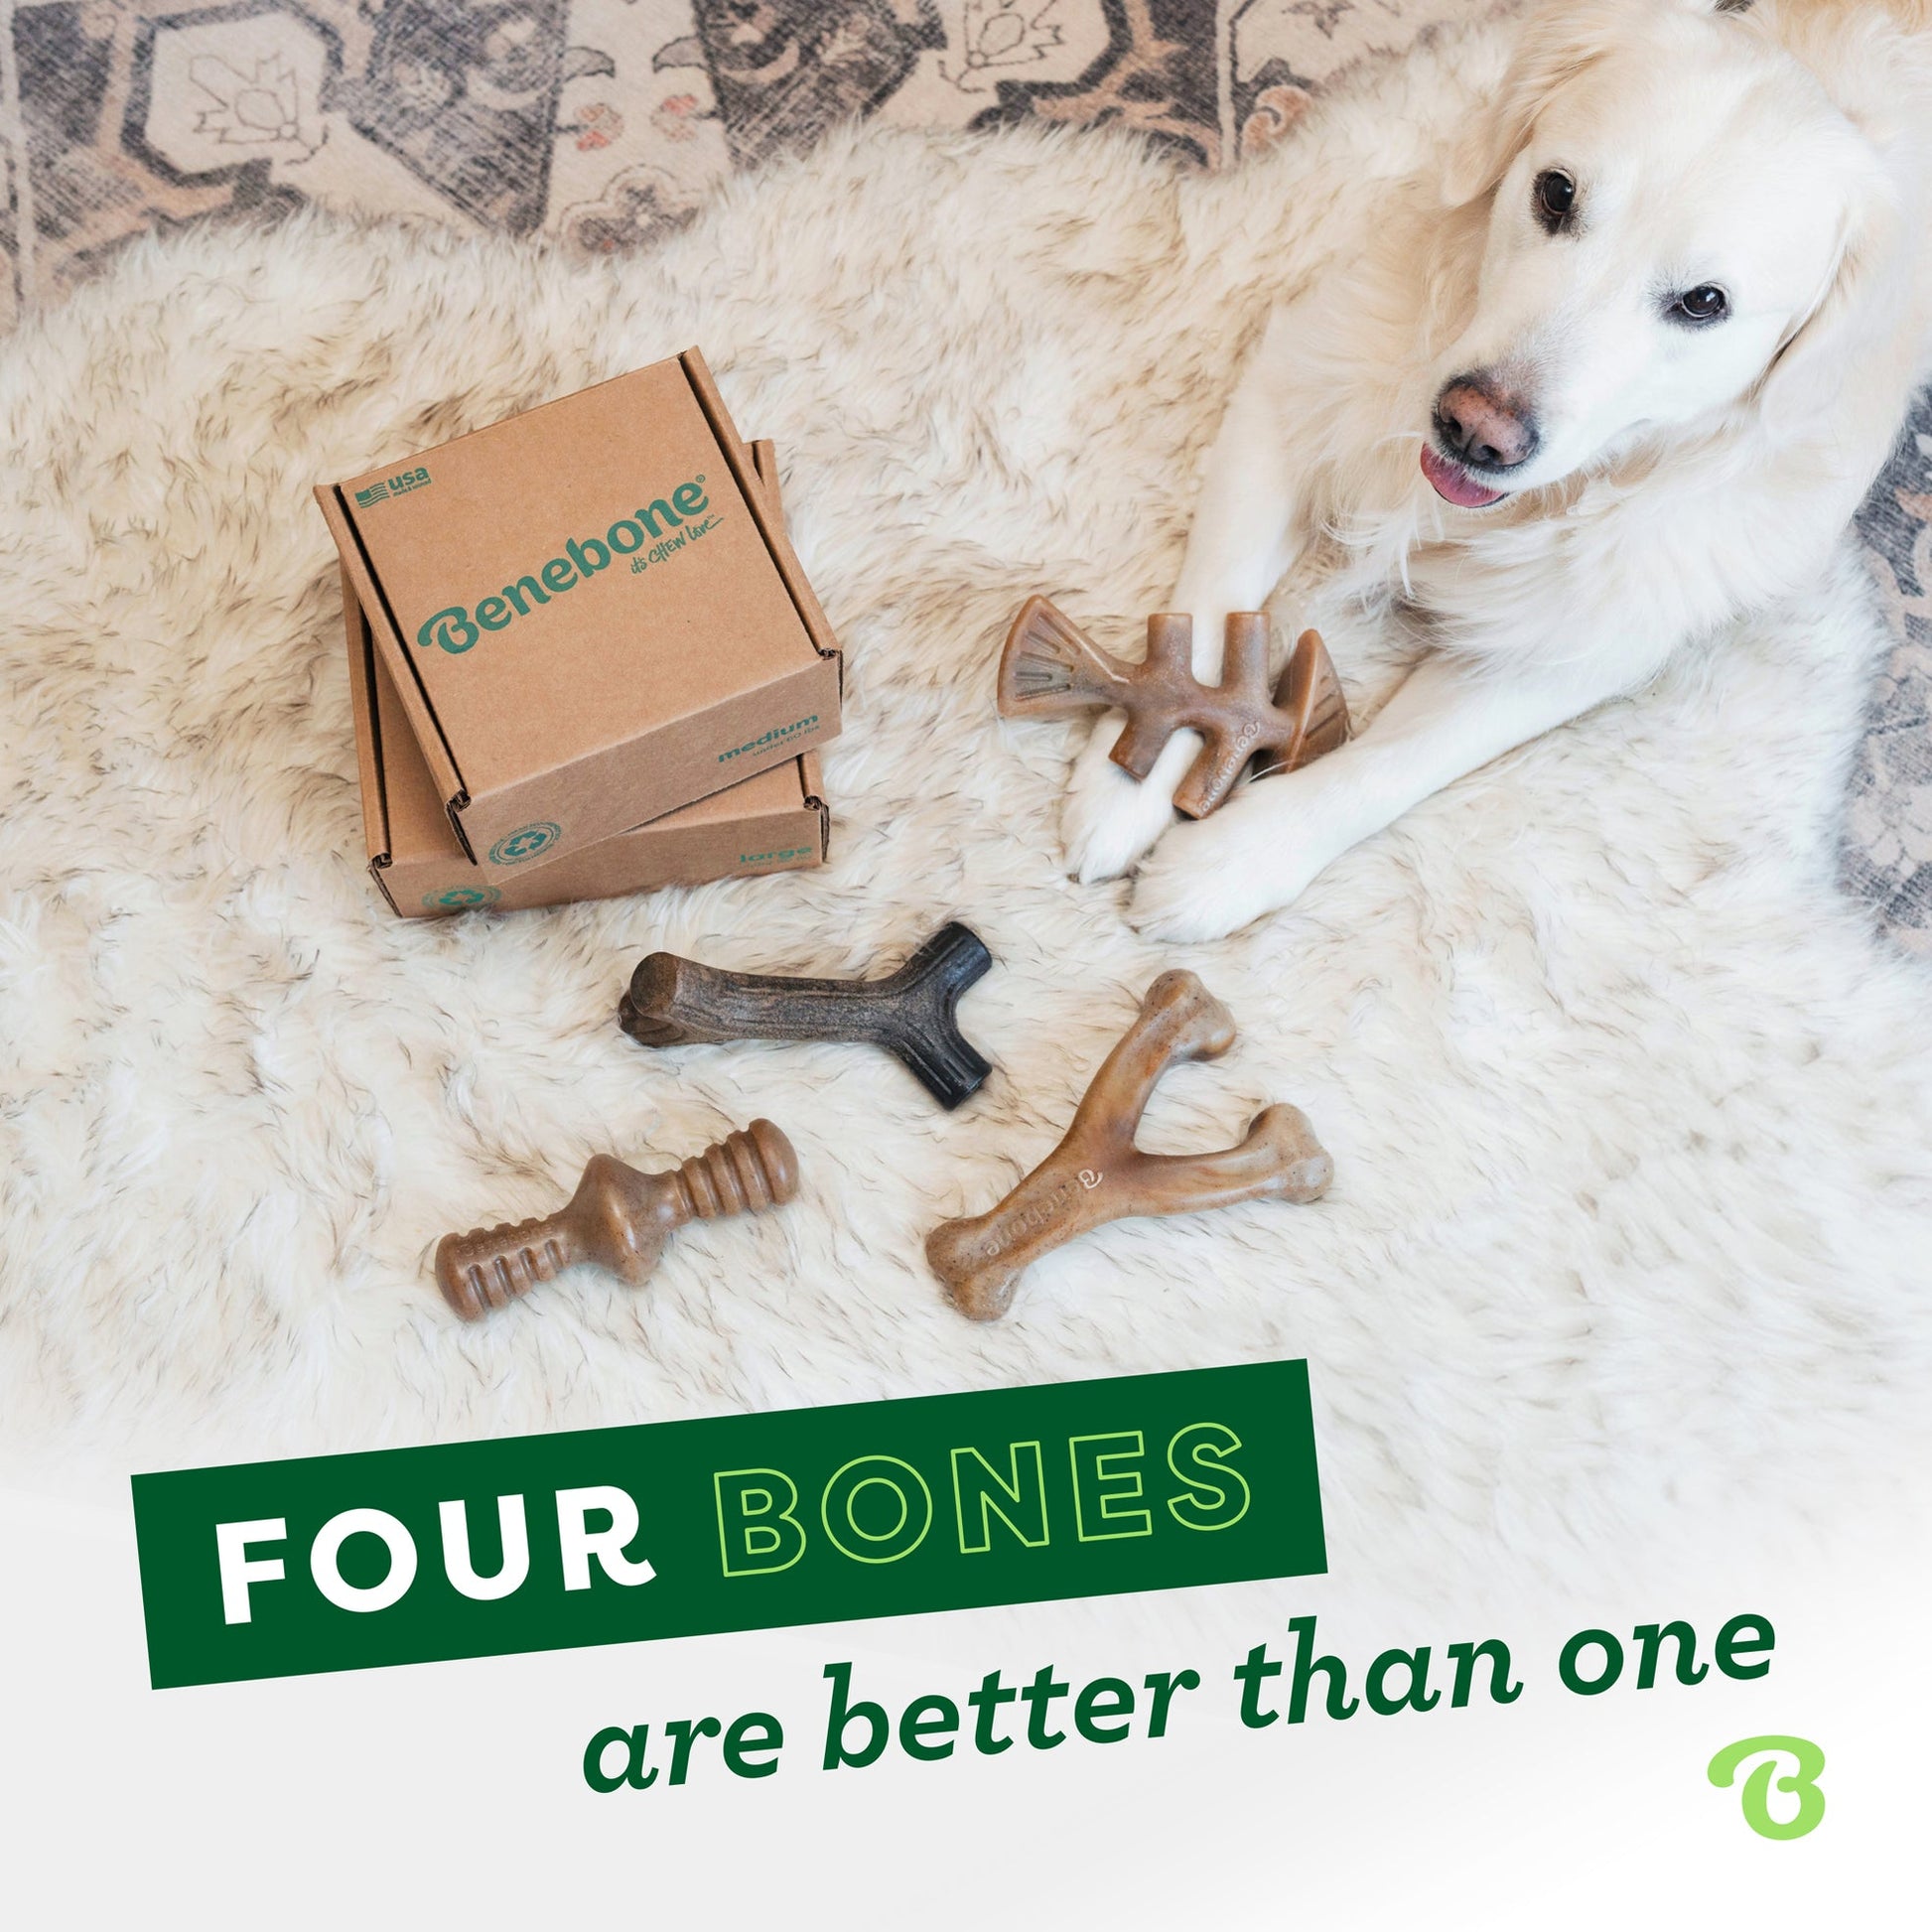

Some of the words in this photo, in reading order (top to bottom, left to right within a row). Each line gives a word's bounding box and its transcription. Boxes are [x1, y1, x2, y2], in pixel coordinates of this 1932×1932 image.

[388, 468, 429, 490] usa
[630, 556, 647, 574] it's
[648, 531, 686, 564] CHEW
[718, 714, 819, 763] medium
[740, 846, 812, 864] large
[986, 1168, 1103, 1257] Benebone
